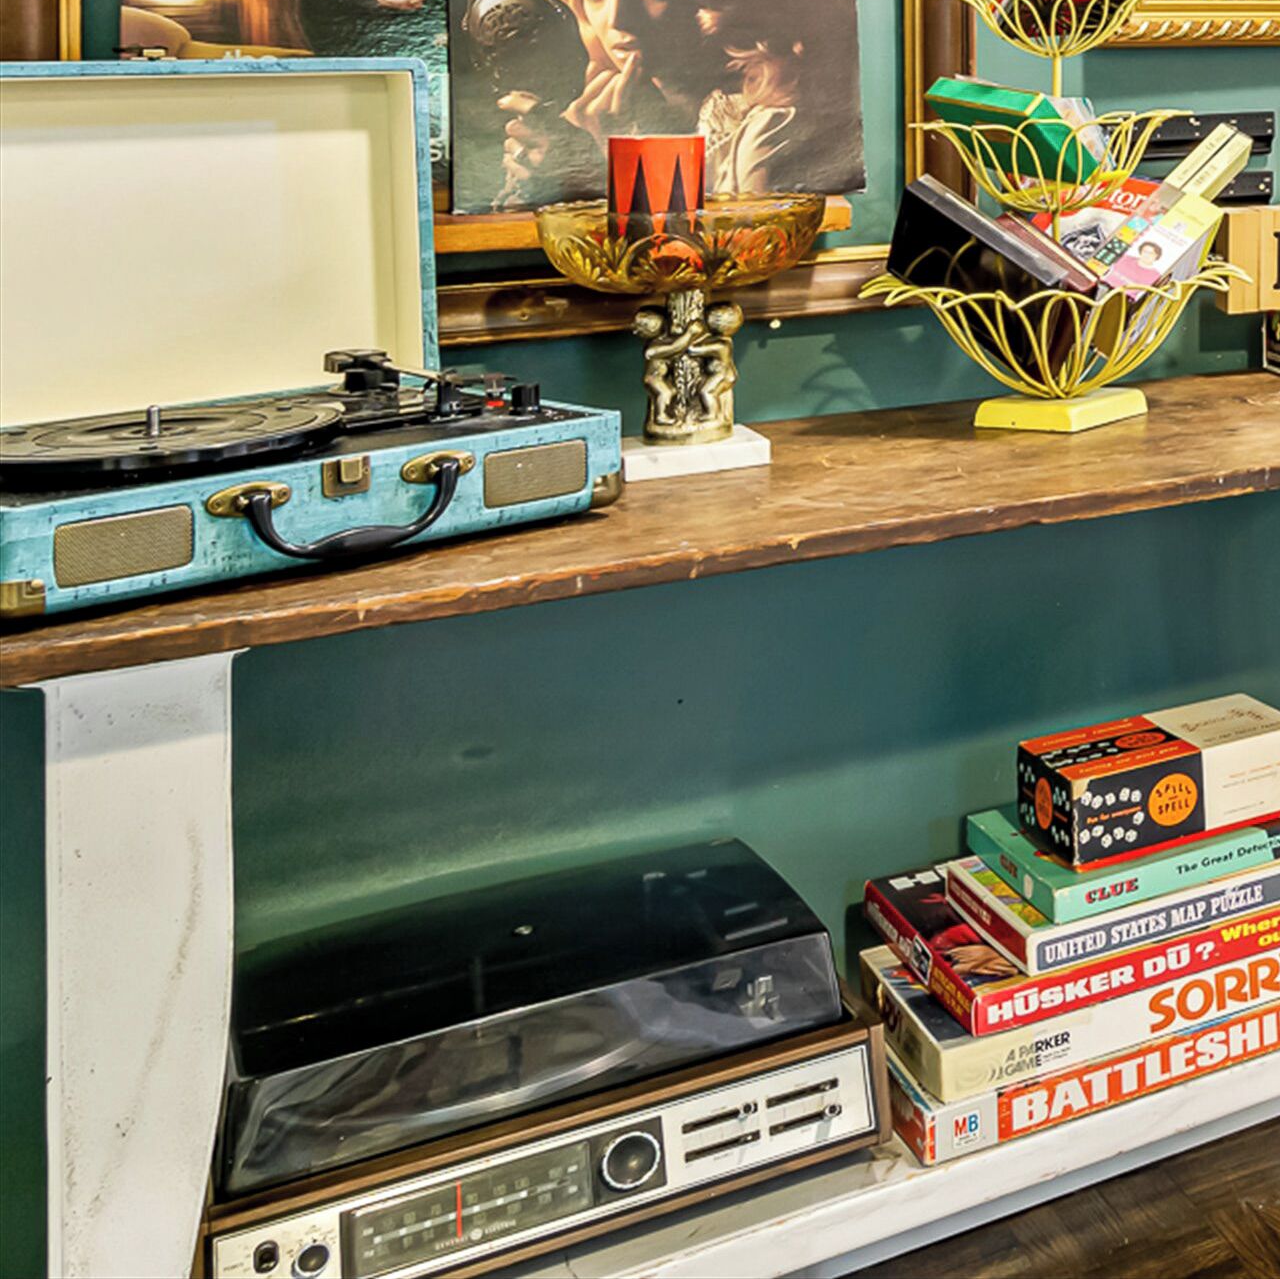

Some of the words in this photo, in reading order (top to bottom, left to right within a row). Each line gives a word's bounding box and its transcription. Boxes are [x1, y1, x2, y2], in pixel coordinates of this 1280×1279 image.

[1155, 783, 1192, 798] SPILL
[1158, 798, 1190, 815] SPELL
[1176, 862, 1198, 876] The
[1202, 851, 1234, 868] Great
[1085, 877, 1139, 905] CLUE
[1045, 930, 1106, 963] UNITED
[1110, 913, 1168, 945] STATES
[1170, 900, 1206, 927] MAP
[1210, 884, 1264, 917] PUZZLE
[1005, 1049, 1017, 1064] A
[1019, 1030, 1071, 1060] PARKER
[1004, 1053, 1042, 1076] GAME
[954, 1113, 979, 1138] MB
